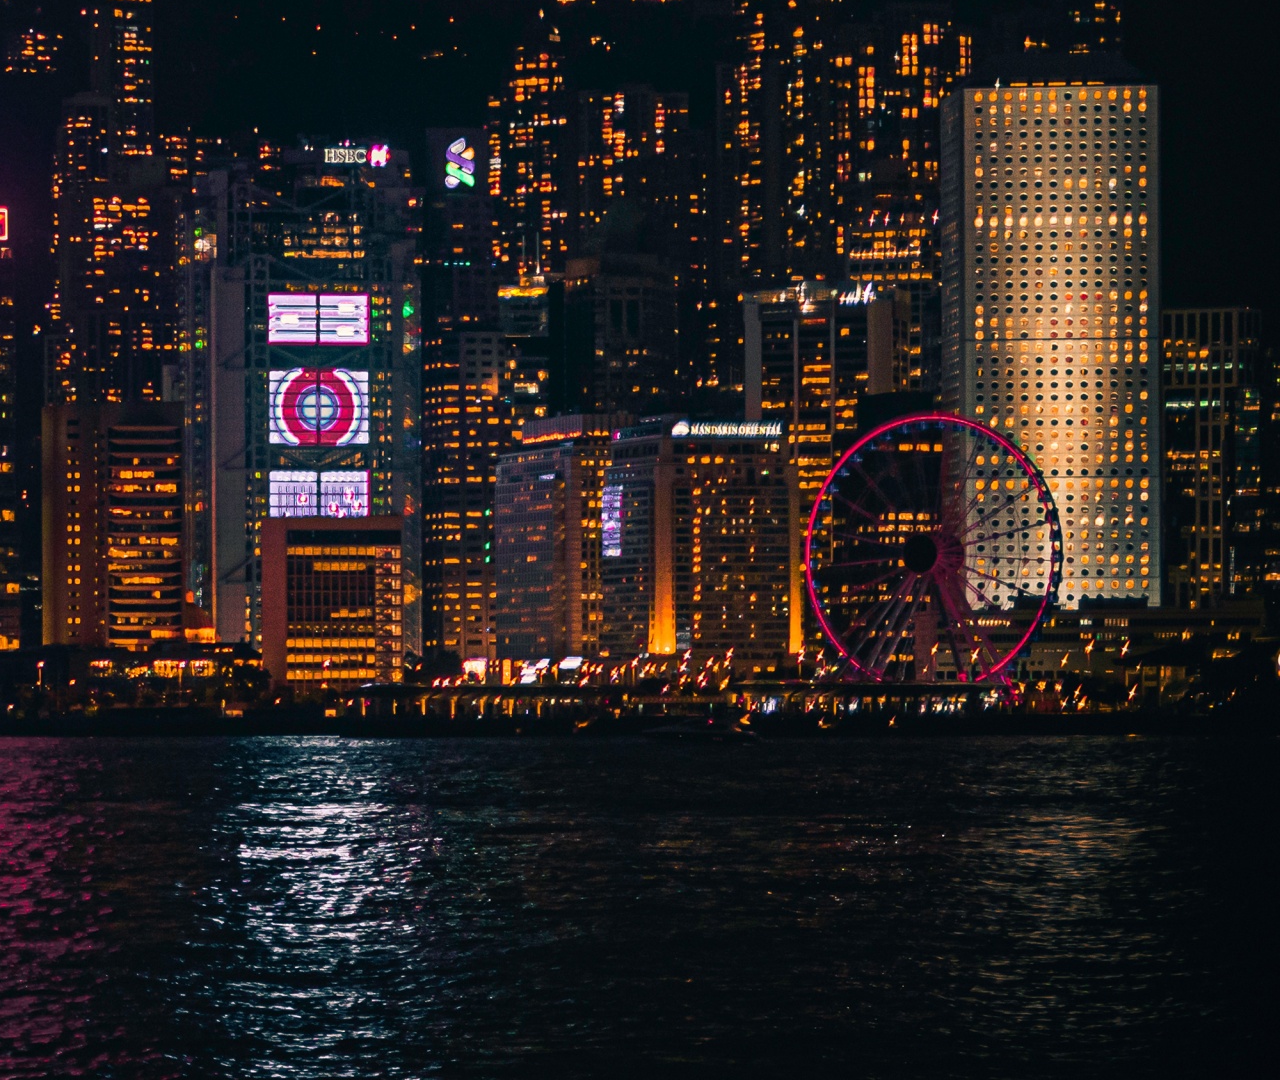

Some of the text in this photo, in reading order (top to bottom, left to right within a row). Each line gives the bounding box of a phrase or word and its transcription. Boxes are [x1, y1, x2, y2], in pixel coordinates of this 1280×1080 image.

[324, 148, 367, 163] HSBC
[690, 423, 782, 436] MANDARIN ORIENTAL
